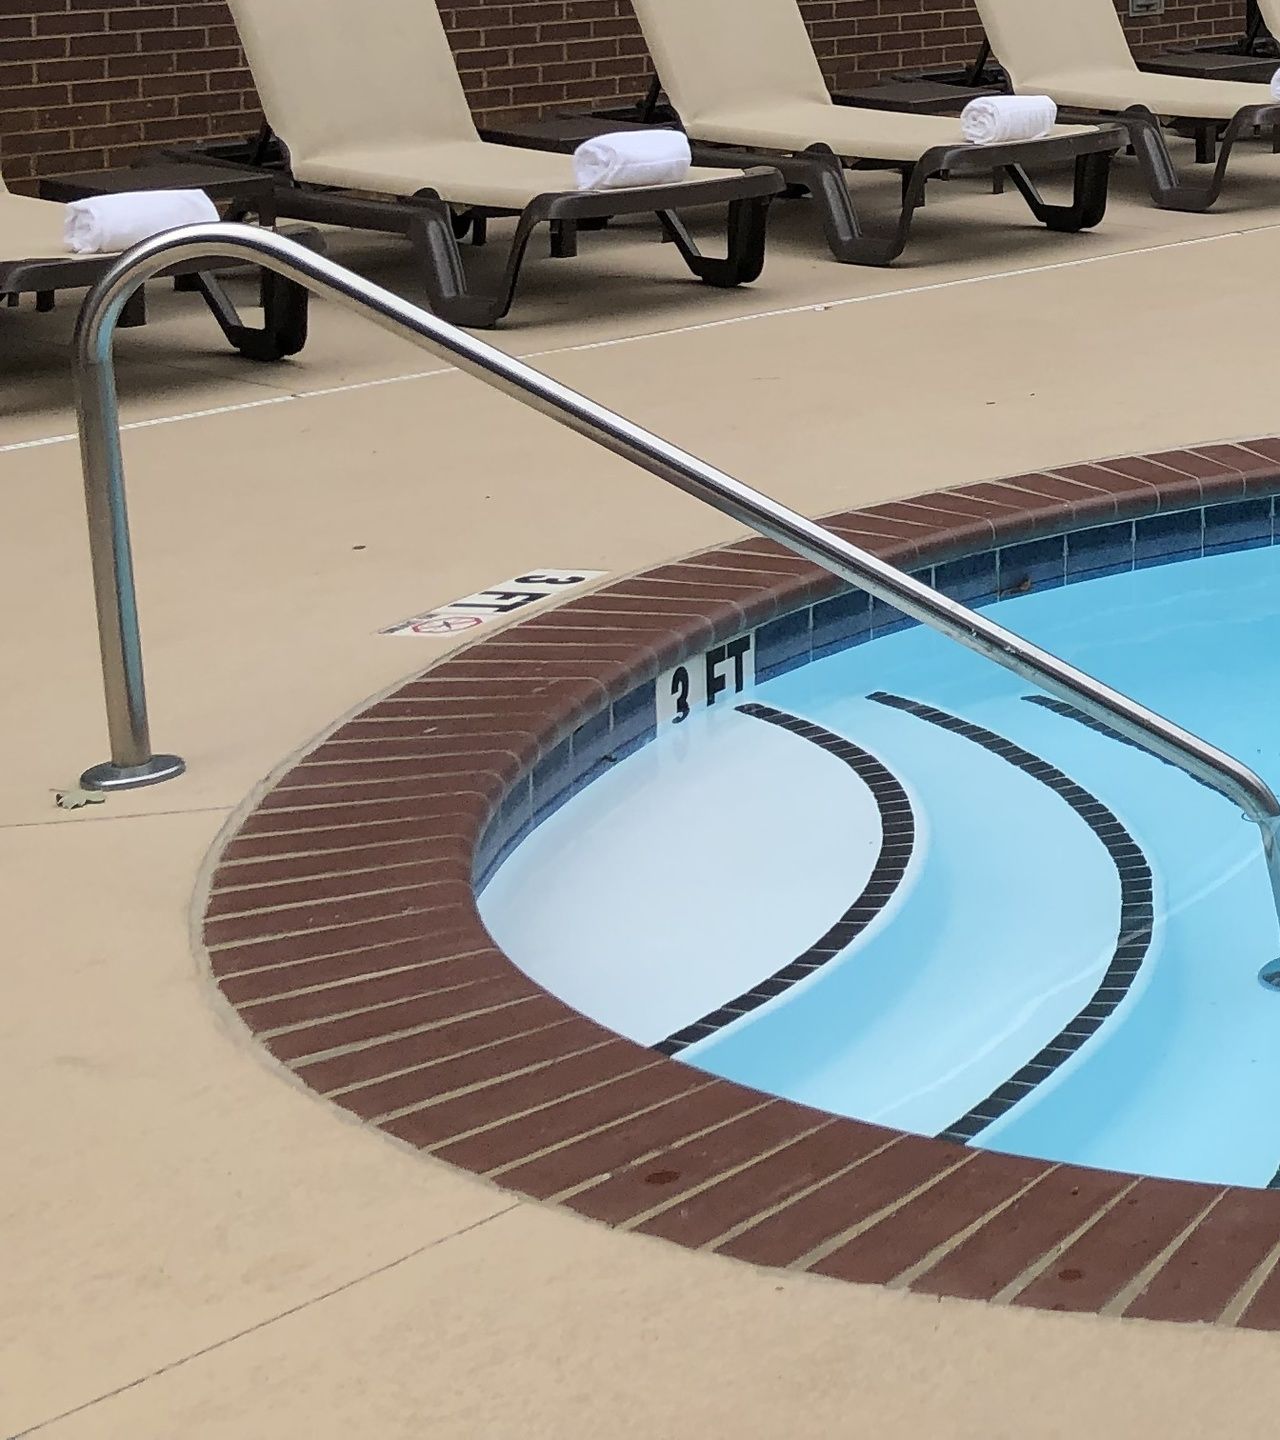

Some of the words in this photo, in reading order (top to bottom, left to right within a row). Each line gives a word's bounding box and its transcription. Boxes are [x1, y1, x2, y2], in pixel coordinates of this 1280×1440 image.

[515, 574, 585, 585] 3
[450, 591, 551, 613] FT
[671, 666, 690, 724] 3
[706, 634, 751, 707] FT
